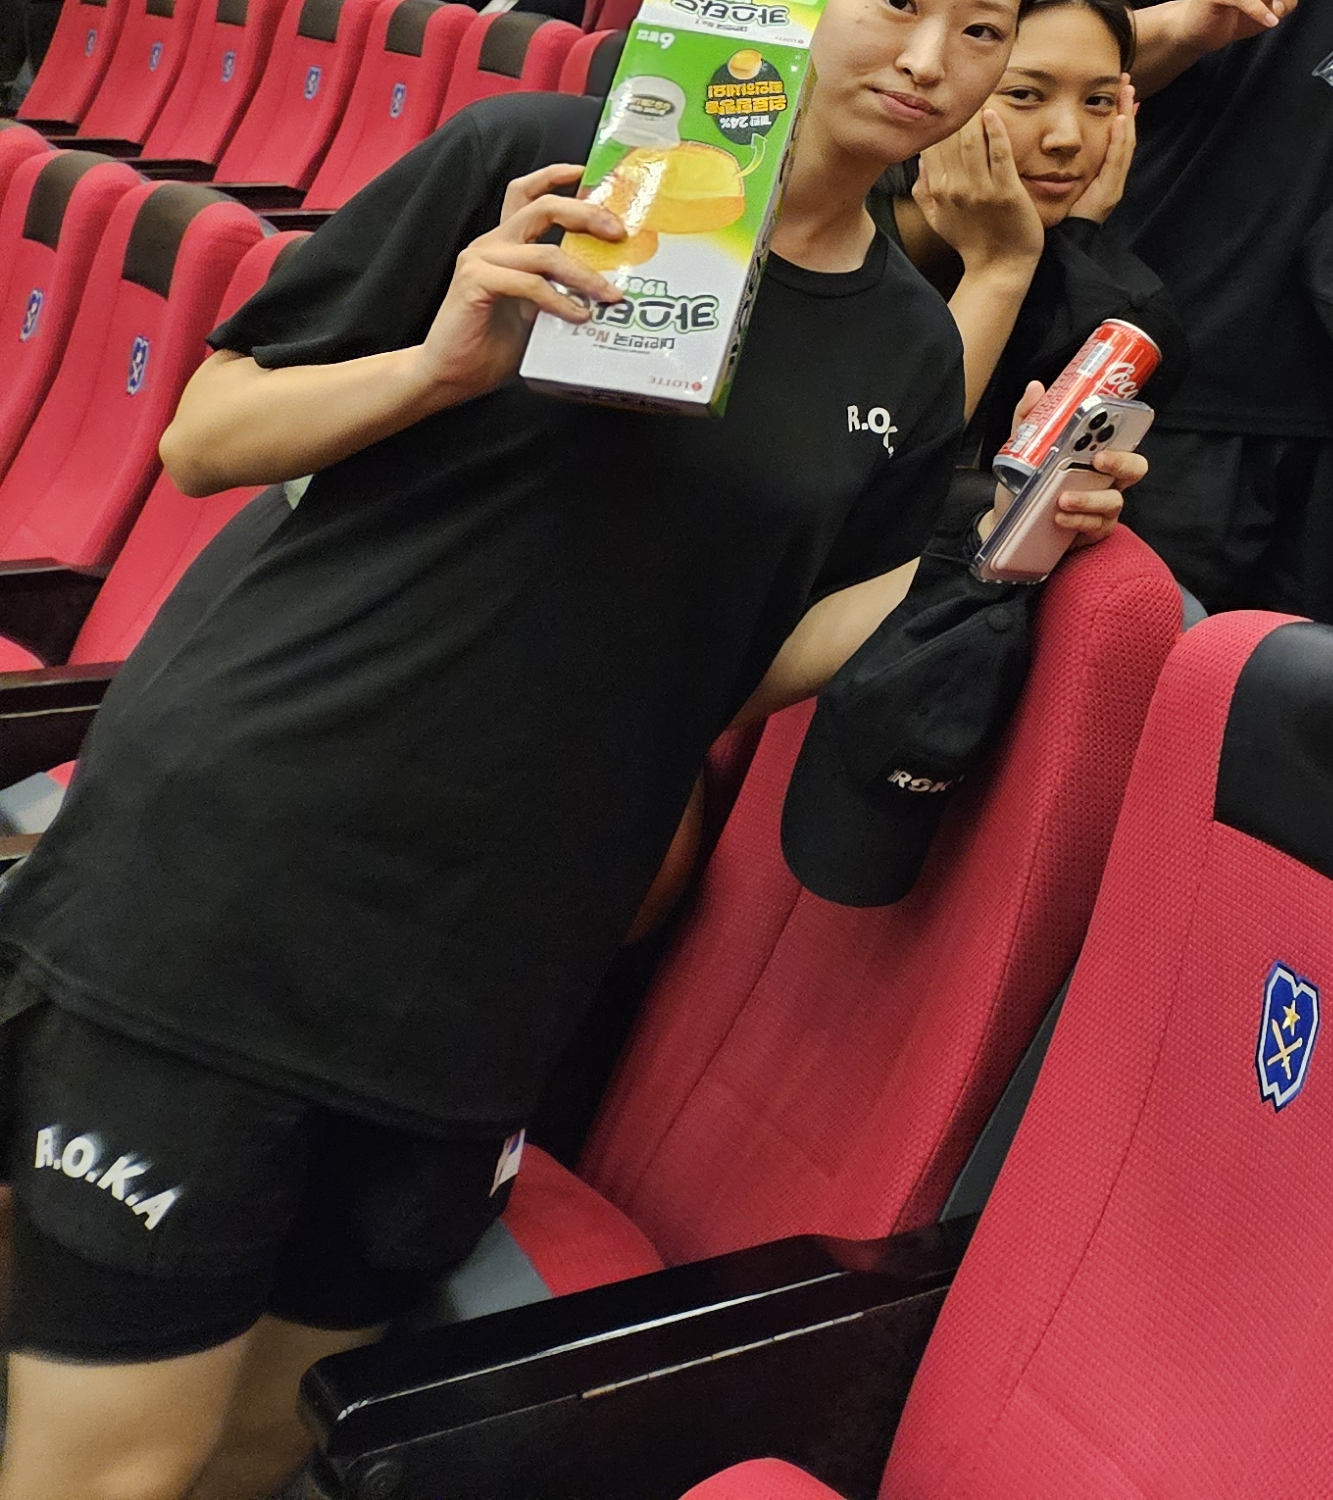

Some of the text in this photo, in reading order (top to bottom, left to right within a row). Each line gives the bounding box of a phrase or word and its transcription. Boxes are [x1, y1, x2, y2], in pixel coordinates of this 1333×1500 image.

[719, 115, 749, 130] 24%
[571, 325, 611, 343] No.1
[613, 333, 676, 350] 대한민국
[36, 1124, 186, 1230] R.O.K.A
